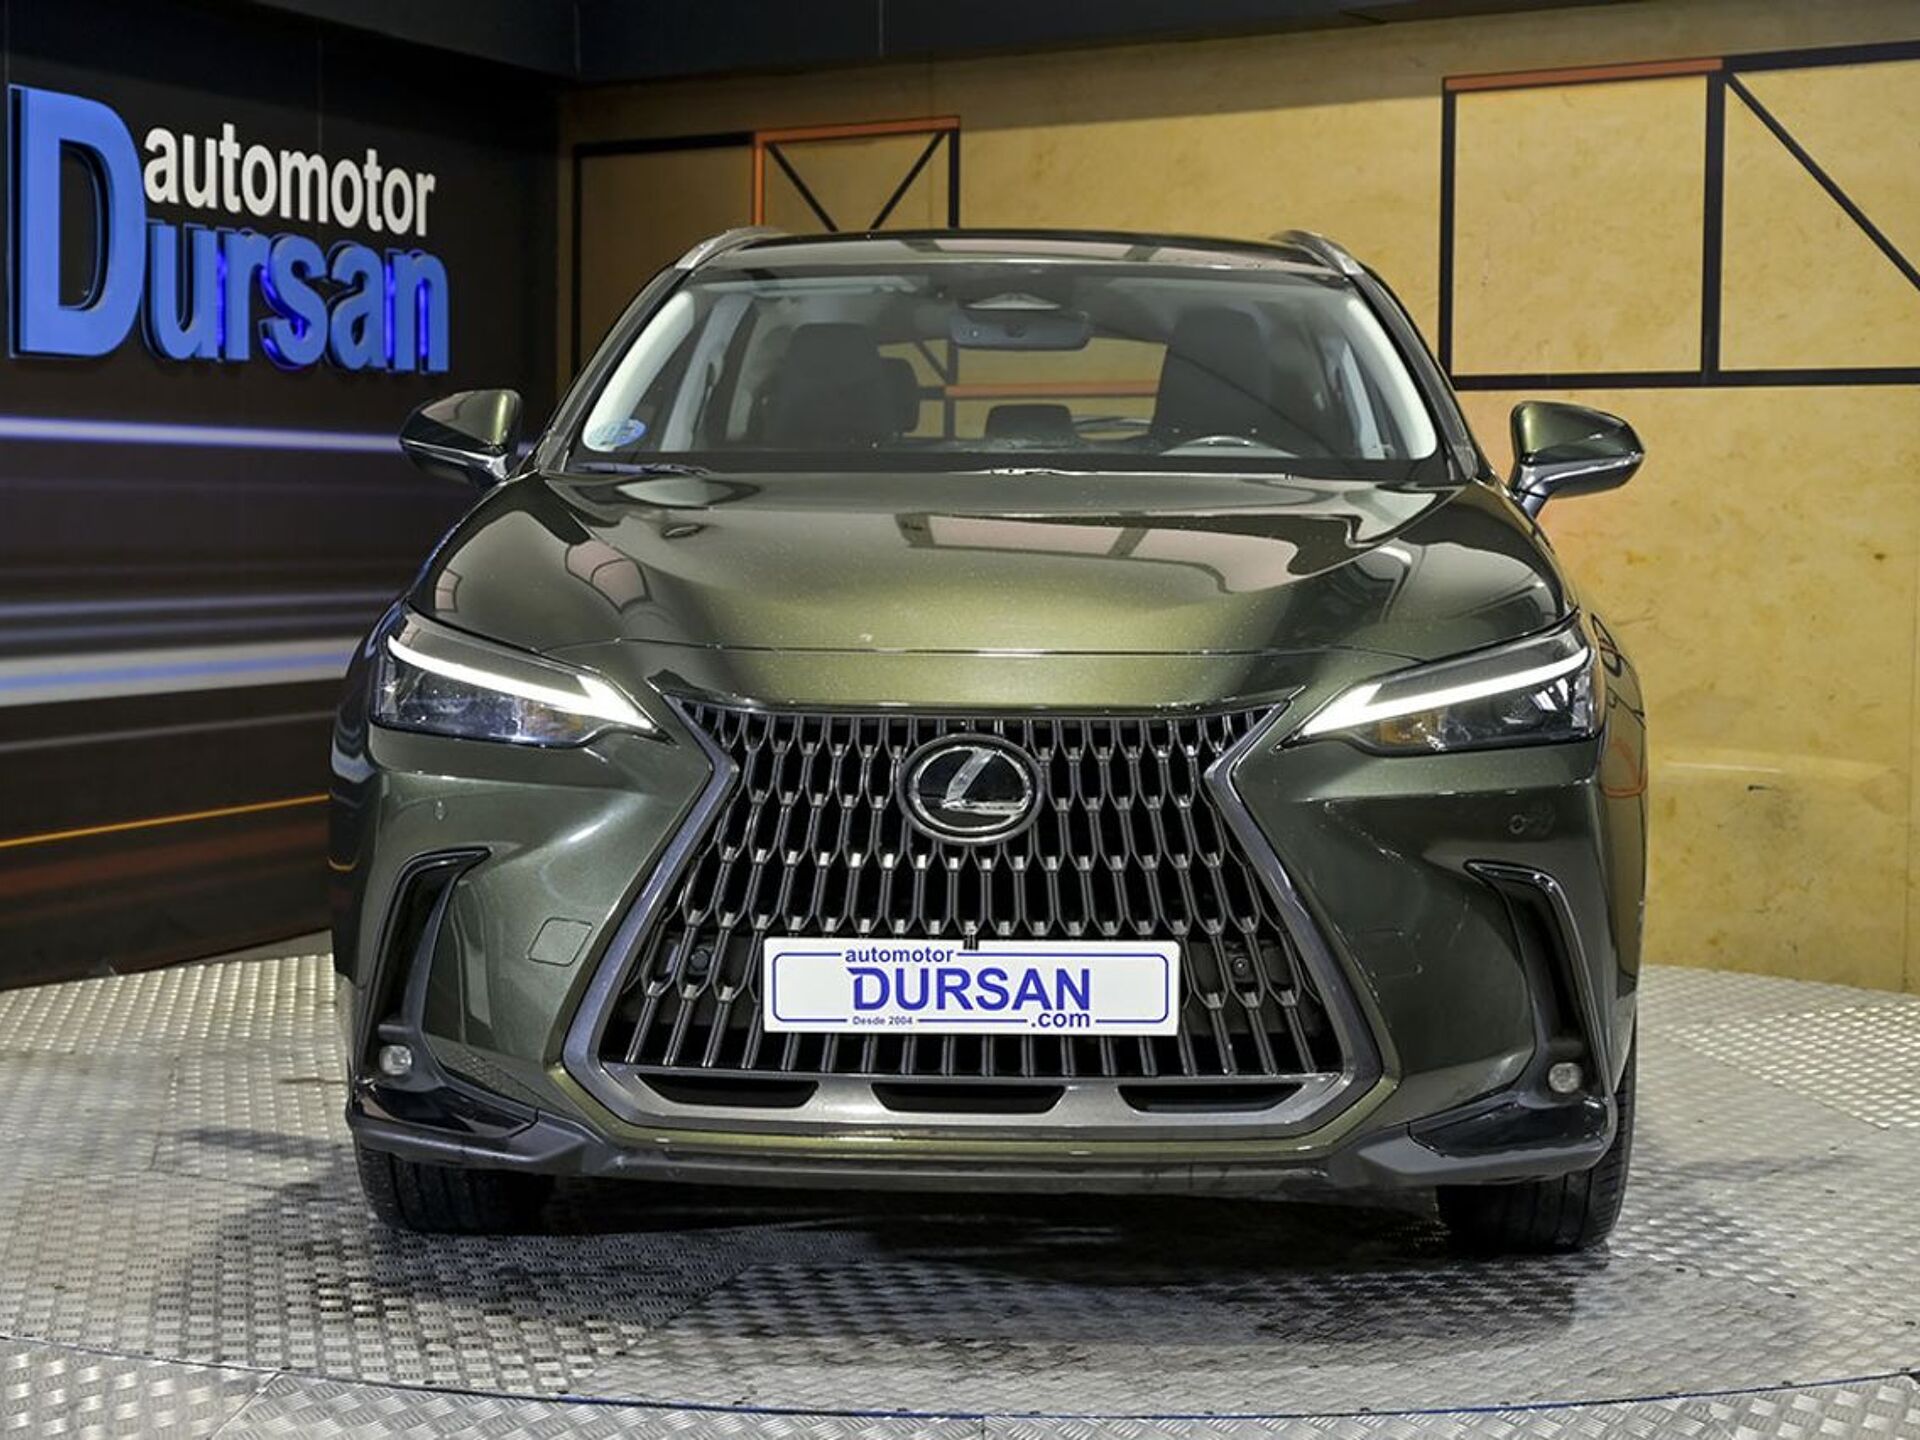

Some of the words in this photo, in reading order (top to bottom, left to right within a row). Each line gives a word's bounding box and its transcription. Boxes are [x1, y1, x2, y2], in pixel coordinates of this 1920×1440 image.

[144, 122, 436, 237] automotor
[8, 83, 450, 374] Dursan
[845, 946, 954, 963] automotor
[846, 967, 1091, 1012] DURSAN
[852, 1015, 886, 1026] Desde
[888, 1015, 913, 1026] 2004
[1029, 1010, 1091, 1029] .com
